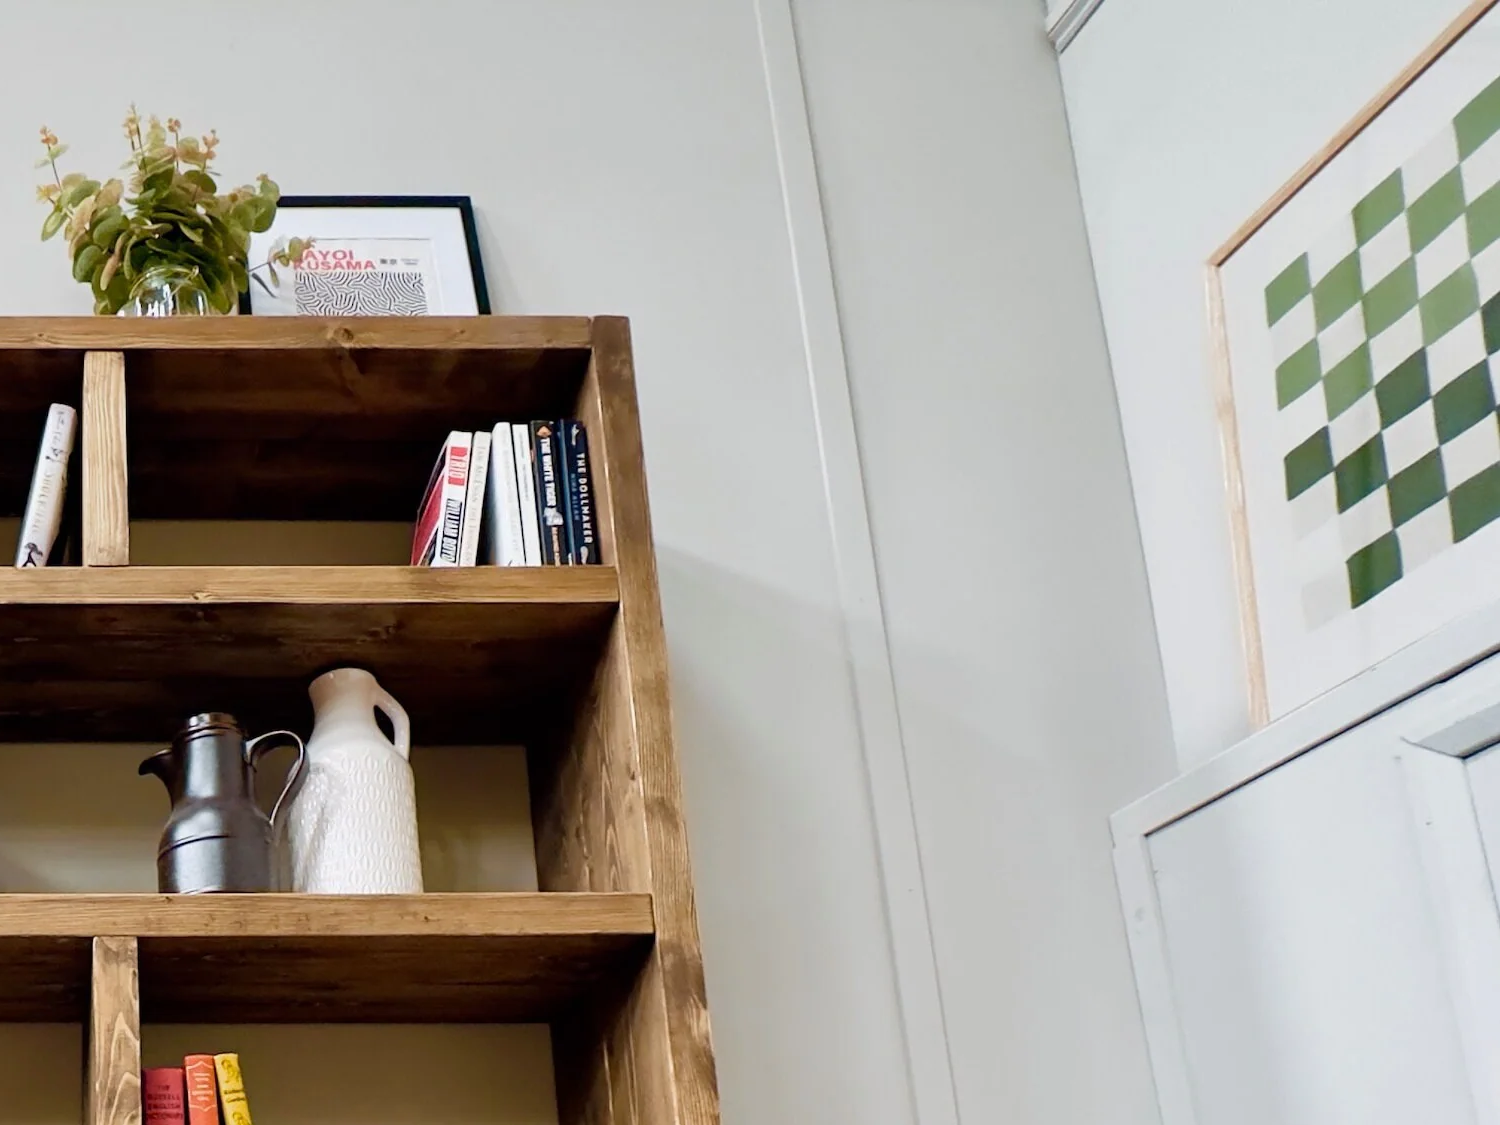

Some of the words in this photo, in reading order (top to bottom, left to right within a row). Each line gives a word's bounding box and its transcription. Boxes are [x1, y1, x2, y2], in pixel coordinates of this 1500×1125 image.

[294, 260, 376, 270] KUSAMA
[298, 250, 354, 260] AYOI
[541, 438, 551, 454] THE
[543, 455, 554, 481] WHITE
[577, 453, 586, 473] THE
[545, 483, 557, 506] TIGER
[444, 499, 462, 535] WILLIAM
[579, 478, 593, 544] DOLLMAKER
[440, 537, 457, 563] BOYD
